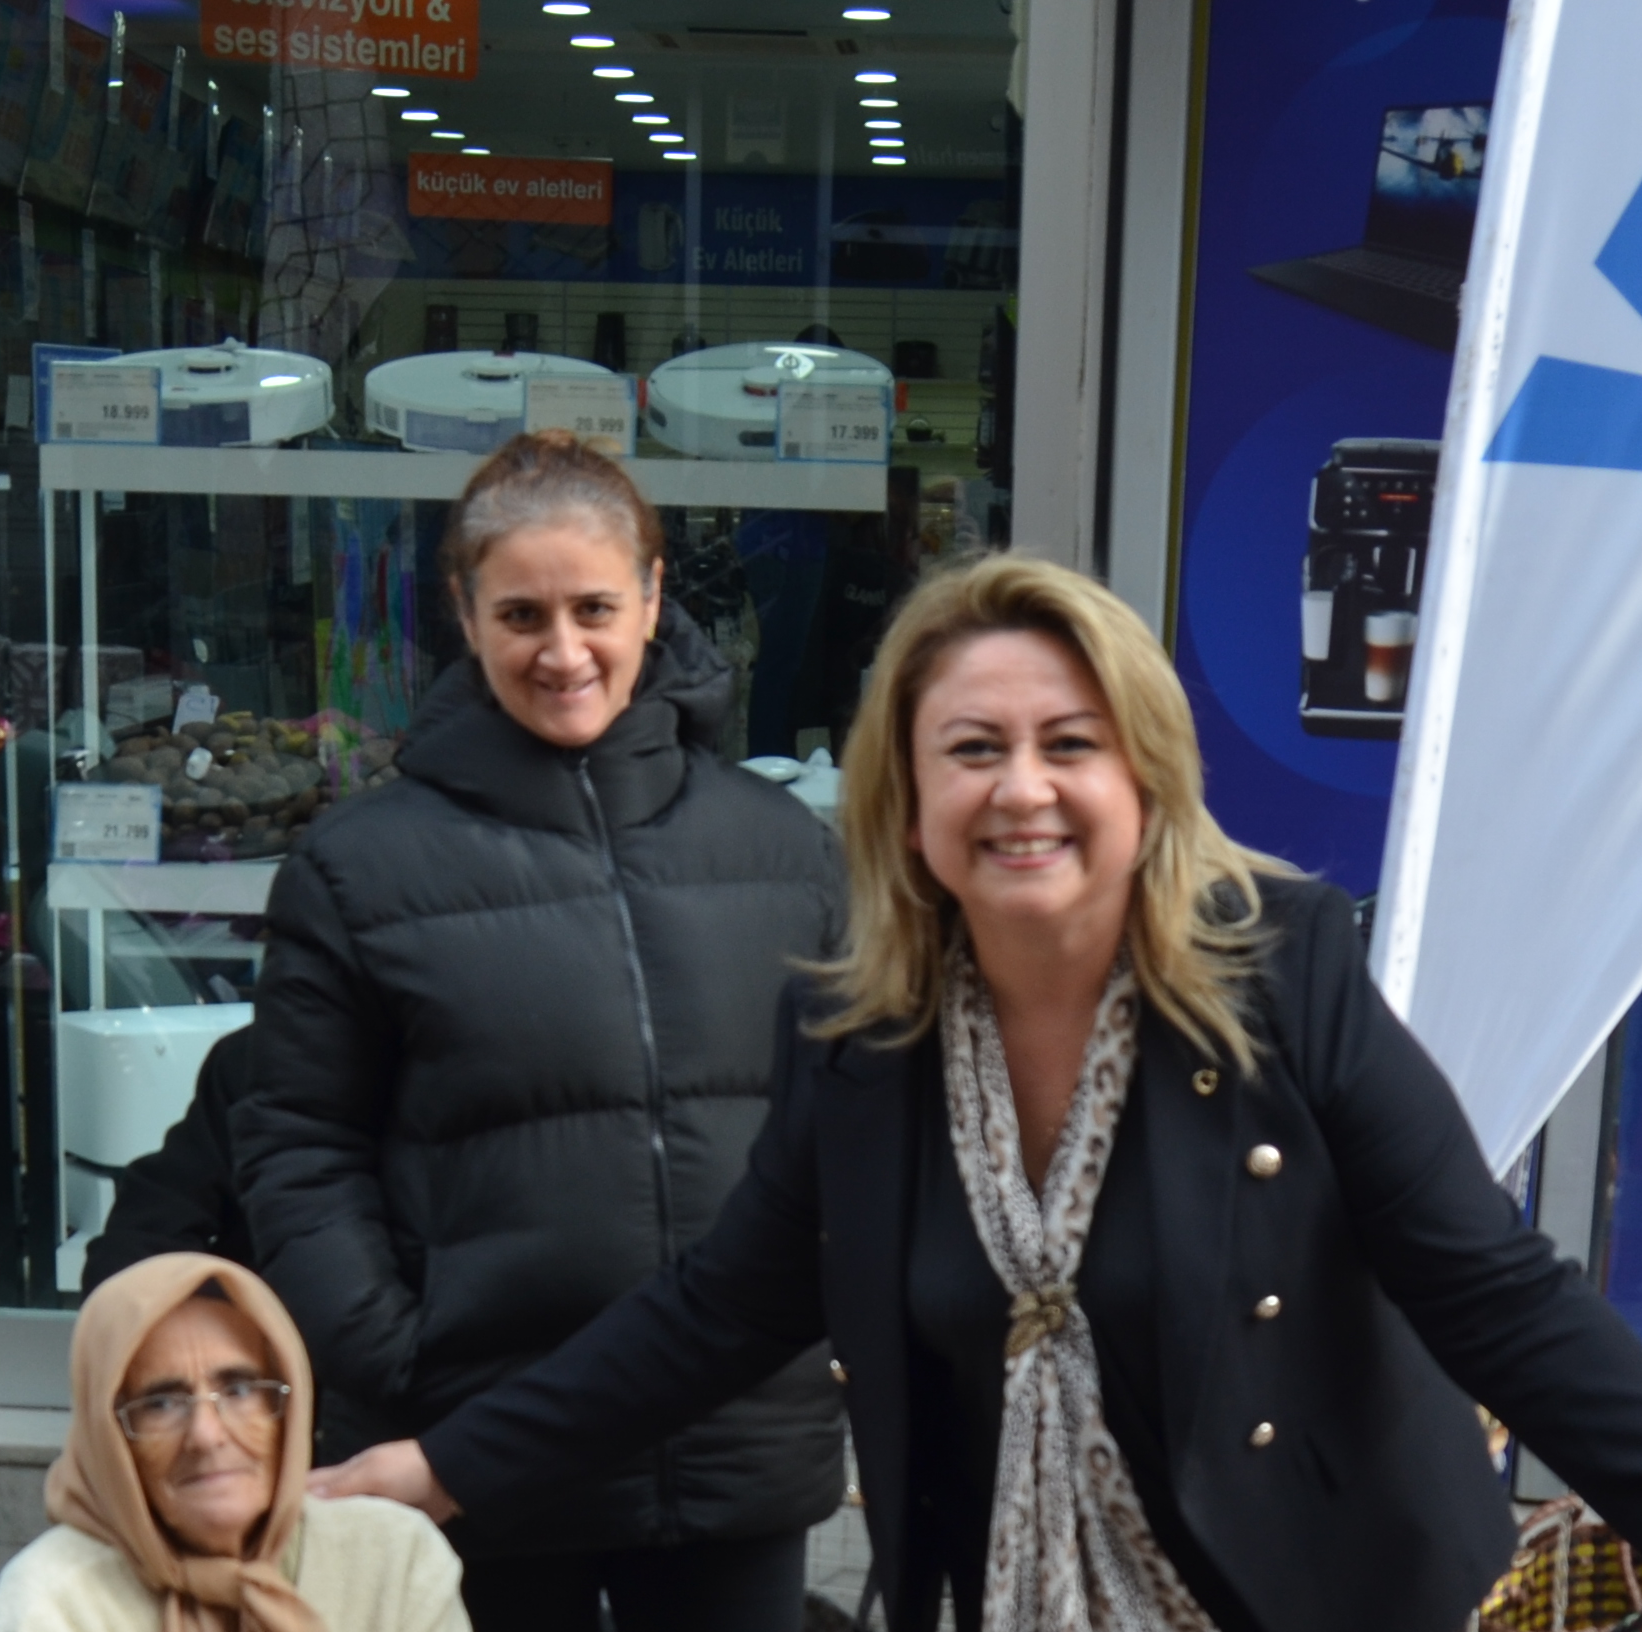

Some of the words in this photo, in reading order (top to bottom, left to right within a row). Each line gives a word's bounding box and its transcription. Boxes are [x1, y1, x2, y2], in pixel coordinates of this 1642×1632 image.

[214, 24, 279, 57] ses
[289, 25, 466, 73] sistemleri
[416, 170, 486, 202] küçük
[493, 179, 520, 196] ev
[526, 173, 604, 200] aletleri
[714, 206, 784, 238] Küçük
[692, 248, 718, 271] Ev
[722, 246, 804, 273] Aletleri
